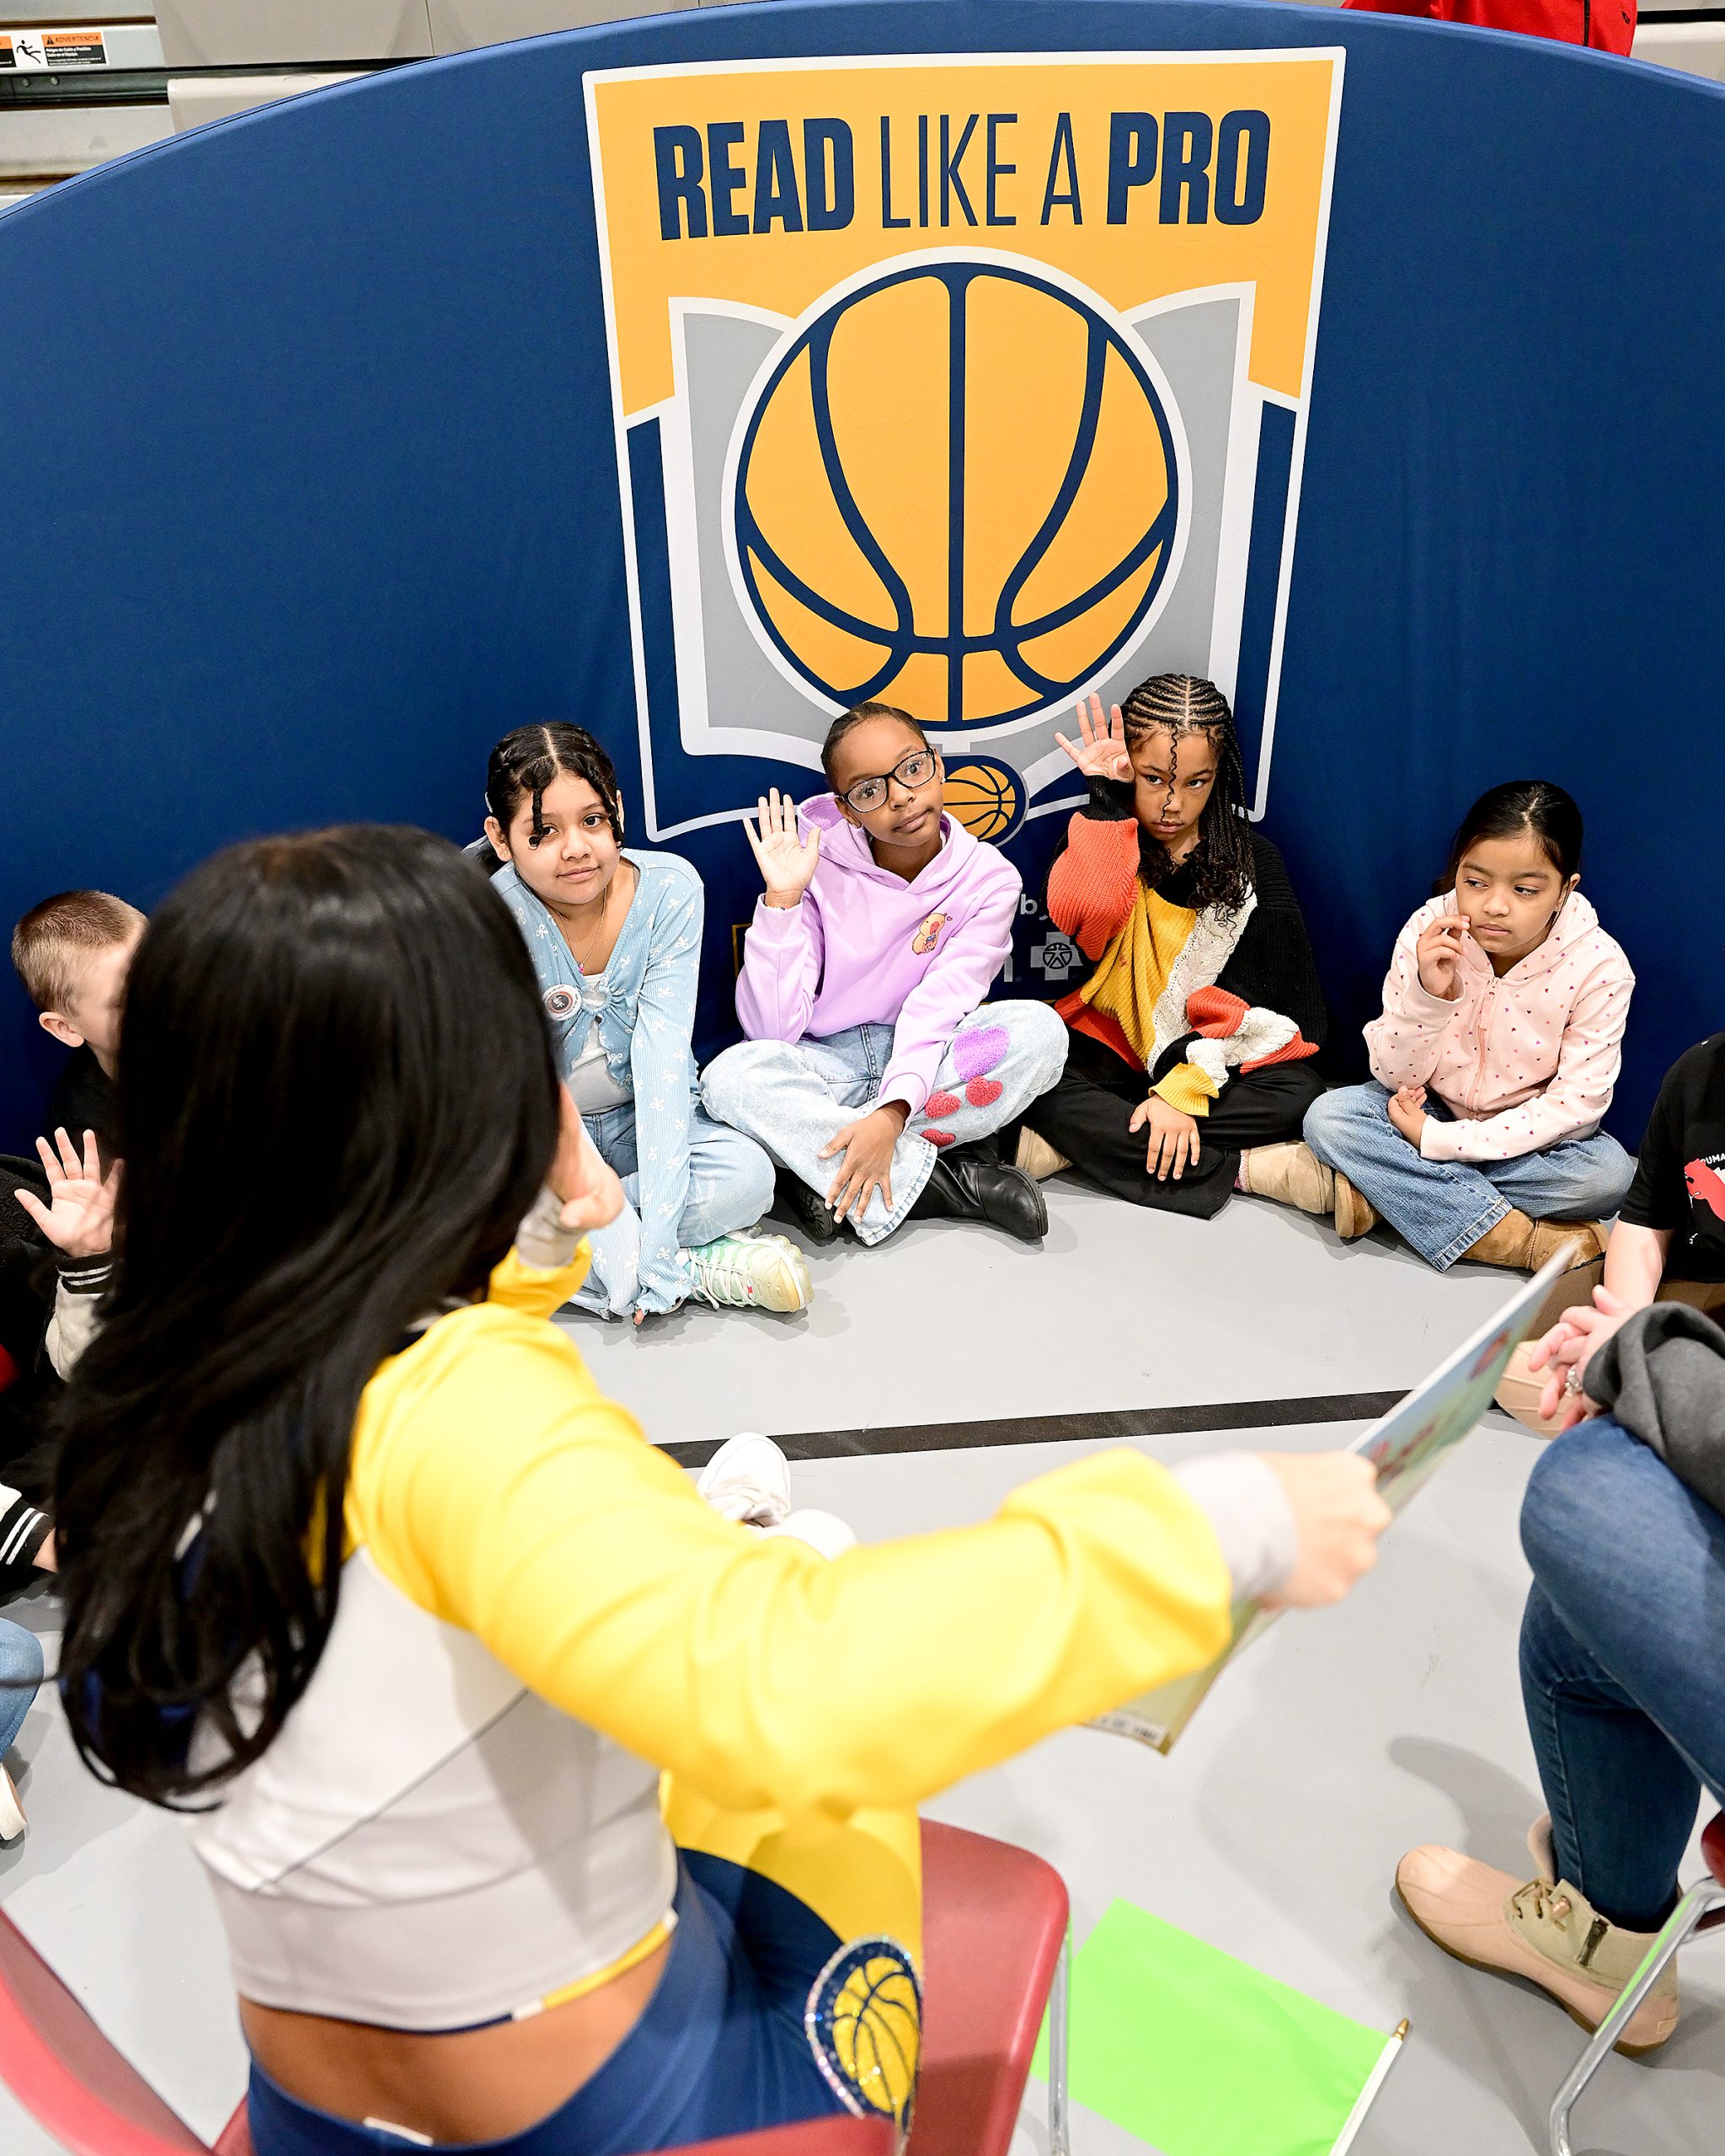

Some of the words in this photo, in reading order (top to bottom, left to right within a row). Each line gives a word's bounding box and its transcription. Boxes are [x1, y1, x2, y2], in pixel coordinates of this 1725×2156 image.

[654, 117, 855, 241] READ
[881, 113, 1017, 229] LIKE
[1040, 112, 1083, 226] A
[1107, 110, 1271, 226] PRO
